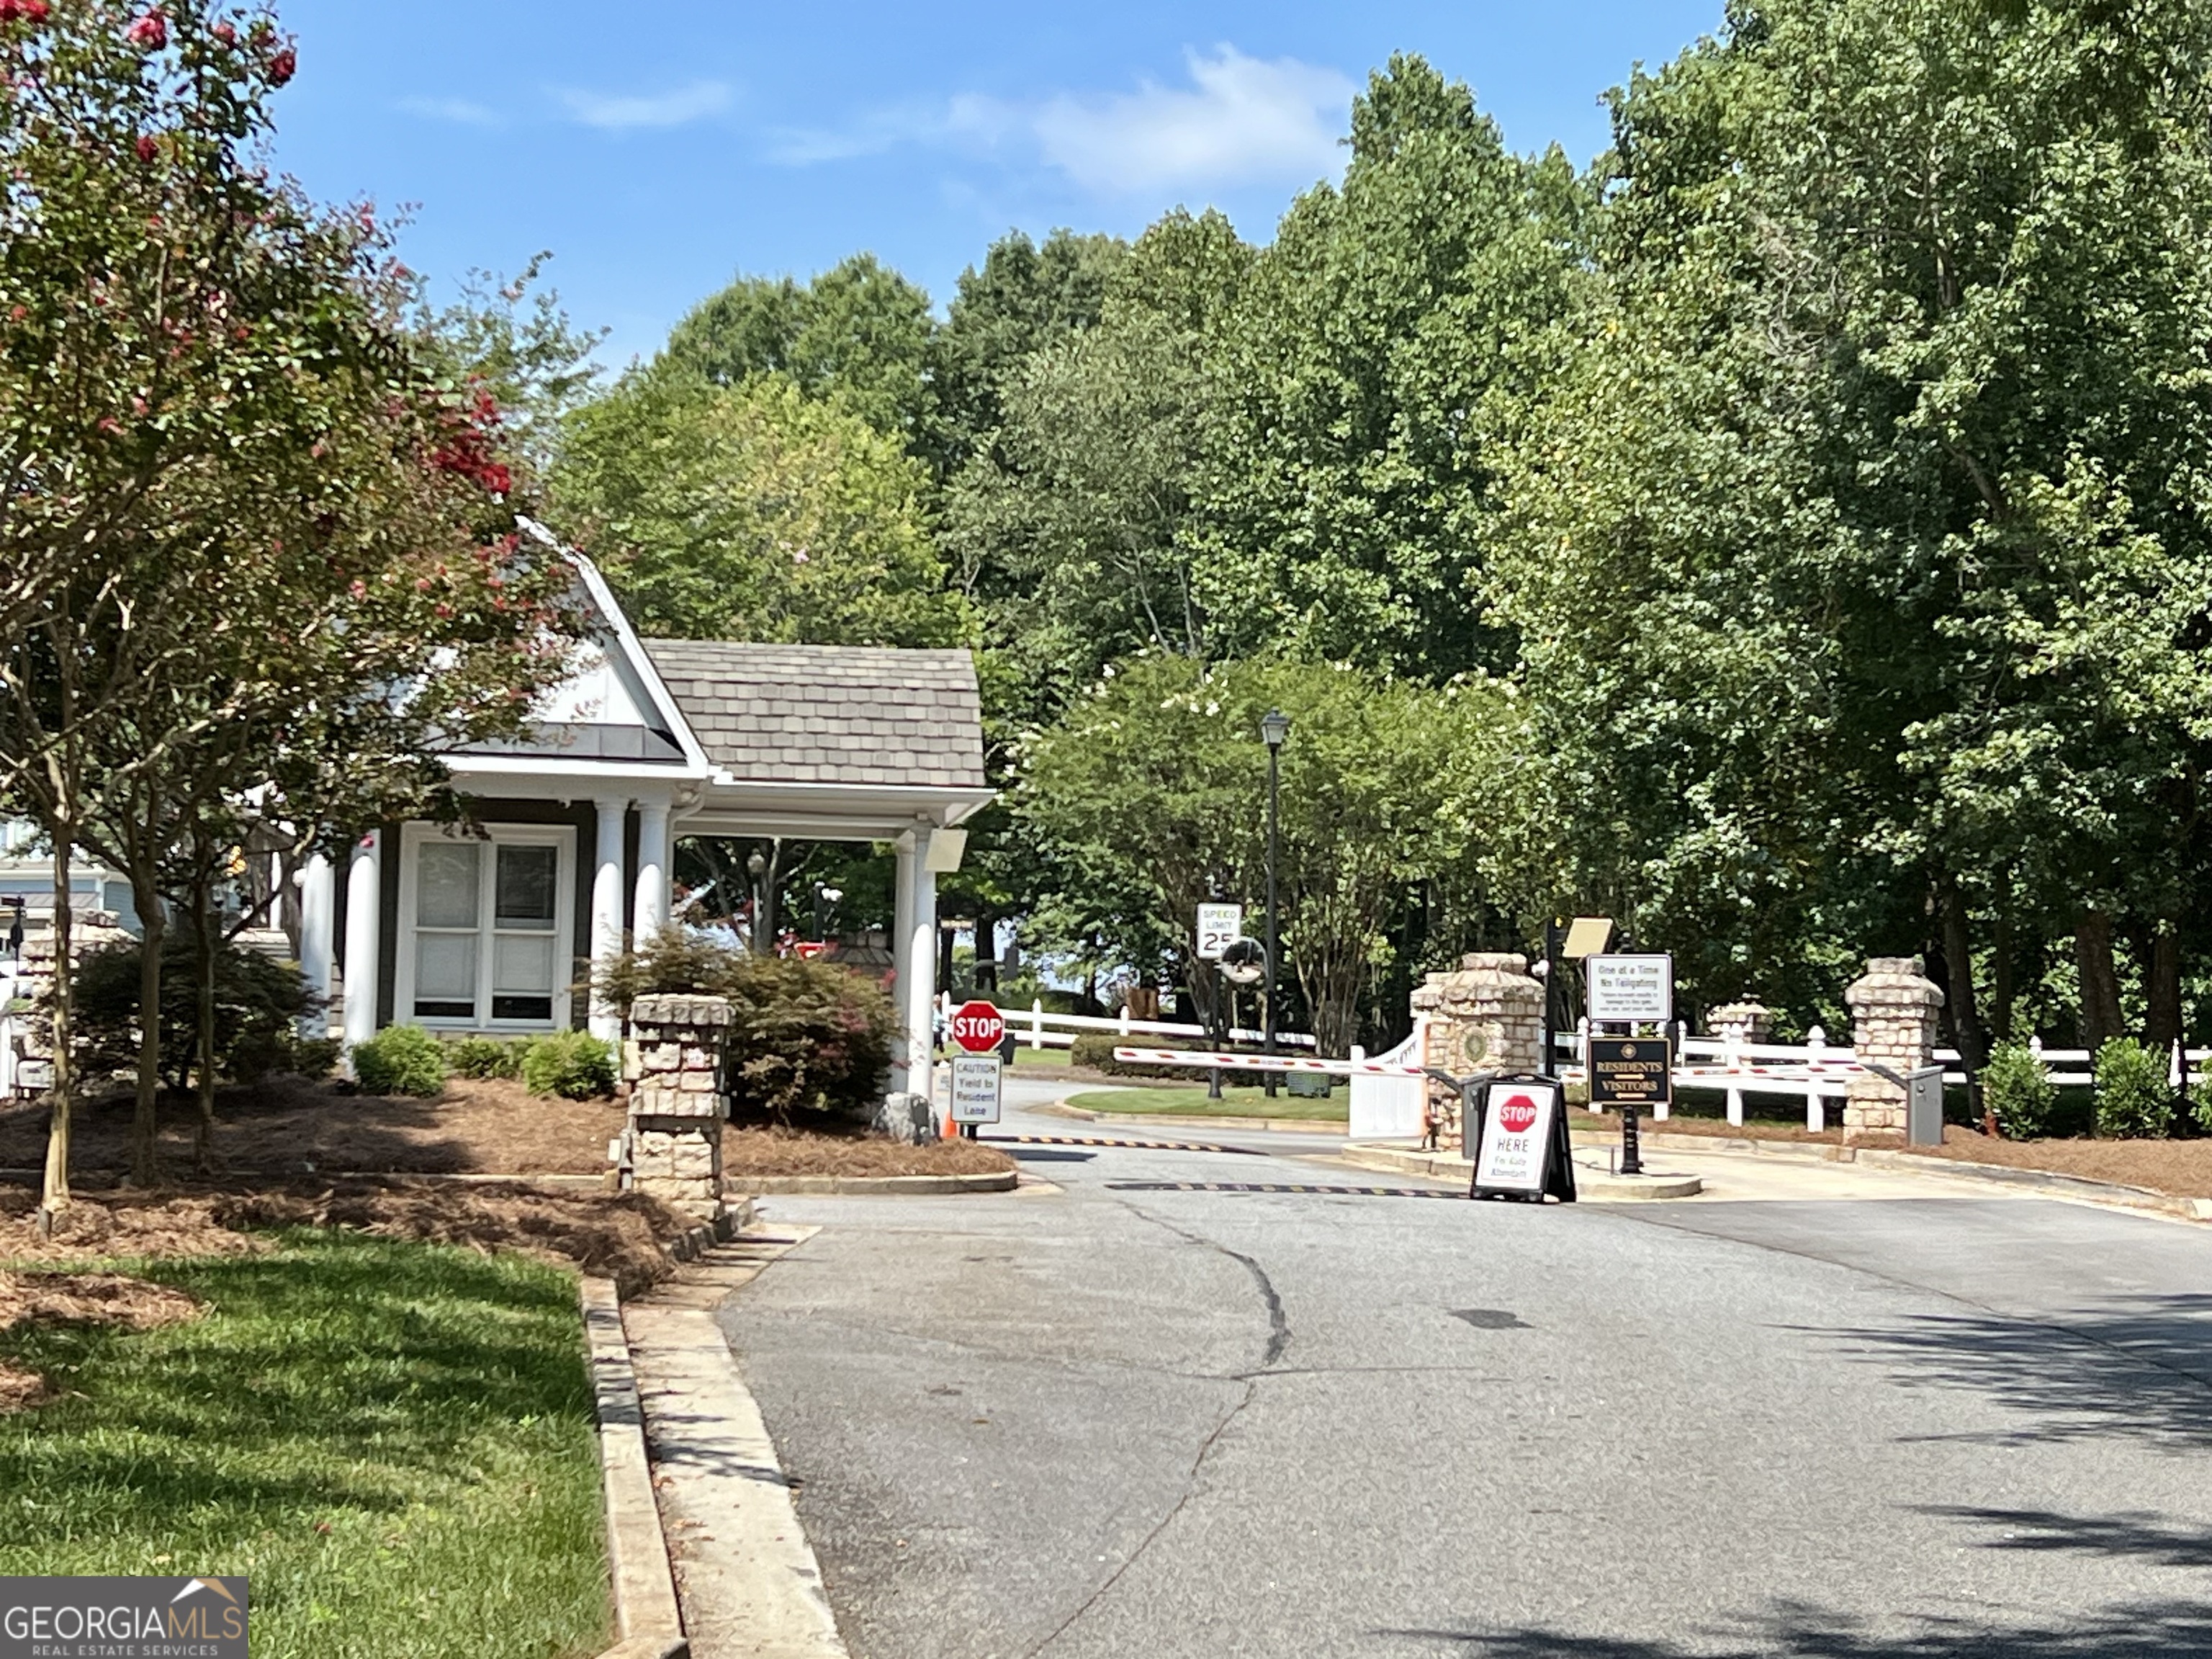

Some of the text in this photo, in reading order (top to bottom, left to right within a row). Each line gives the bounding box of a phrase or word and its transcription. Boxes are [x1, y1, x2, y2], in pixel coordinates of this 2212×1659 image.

[1204, 933, 1233, 950] 25
[956, 1017, 1001, 1038] STOP
[956, 1064, 997, 1074] CAUTION
[1596, 1062, 1663, 1072] RESIDENTS
[959, 1079, 981, 1088] Yield
[1601, 1081, 1658, 1091] VISITORS
[957, 1092, 995, 1102] Resident
[964, 1106, 986, 1115] Lane
[1501, 1106, 1535, 1123] STOP
[1497, 1138, 1529, 1153] HERE
